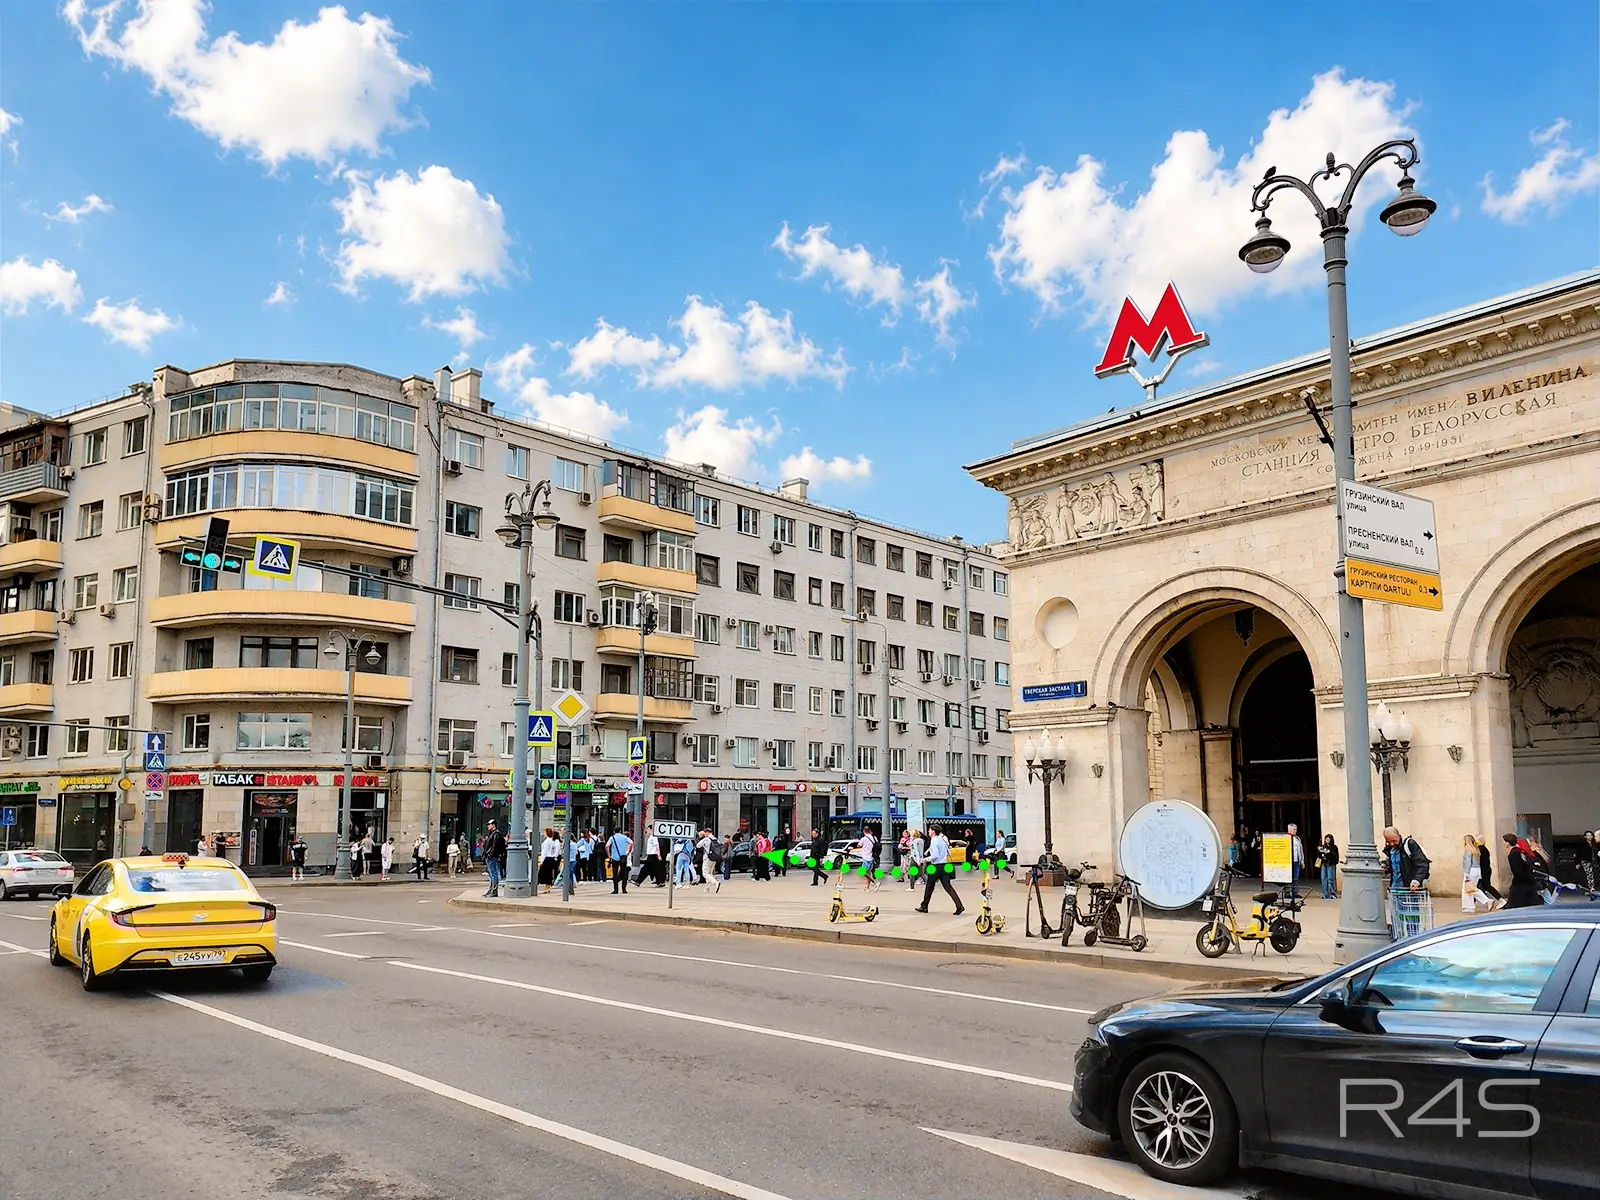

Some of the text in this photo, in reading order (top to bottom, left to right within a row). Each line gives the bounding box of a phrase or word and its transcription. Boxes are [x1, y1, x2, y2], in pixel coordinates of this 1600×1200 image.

[1242, 392, 1556, 477] СТАНЦИЯ ТРО БЕЛОРУССКАЯ
[1316, 451, 1394, 474] СОЖЕНА
[1345, 488, 1405, 510] ГРУЗИНСКИЙ ВАЛ
[1346, 501, 1367, 512] улица
[1348, 526, 1414, 548] ПРЕСНЕНСКИЙ ВАЛ
[1348, 540, 1369, 550] улица
[1350, 567, 1418, 586] ГРУЗИНСКИЙ РЕСТОРАН
[1351, 579, 1412, 596] КАРТУЛИ QARTULI
[1024, 687, 1048, 695] ТВЕРСКАЯ
[1076, 683, 1081, 693] 1
[213, 774, 254, 785] ТАБАК
[711, 781, 765, 791] SUNLIGHT
[658, 823, 691, 836] СТОП
